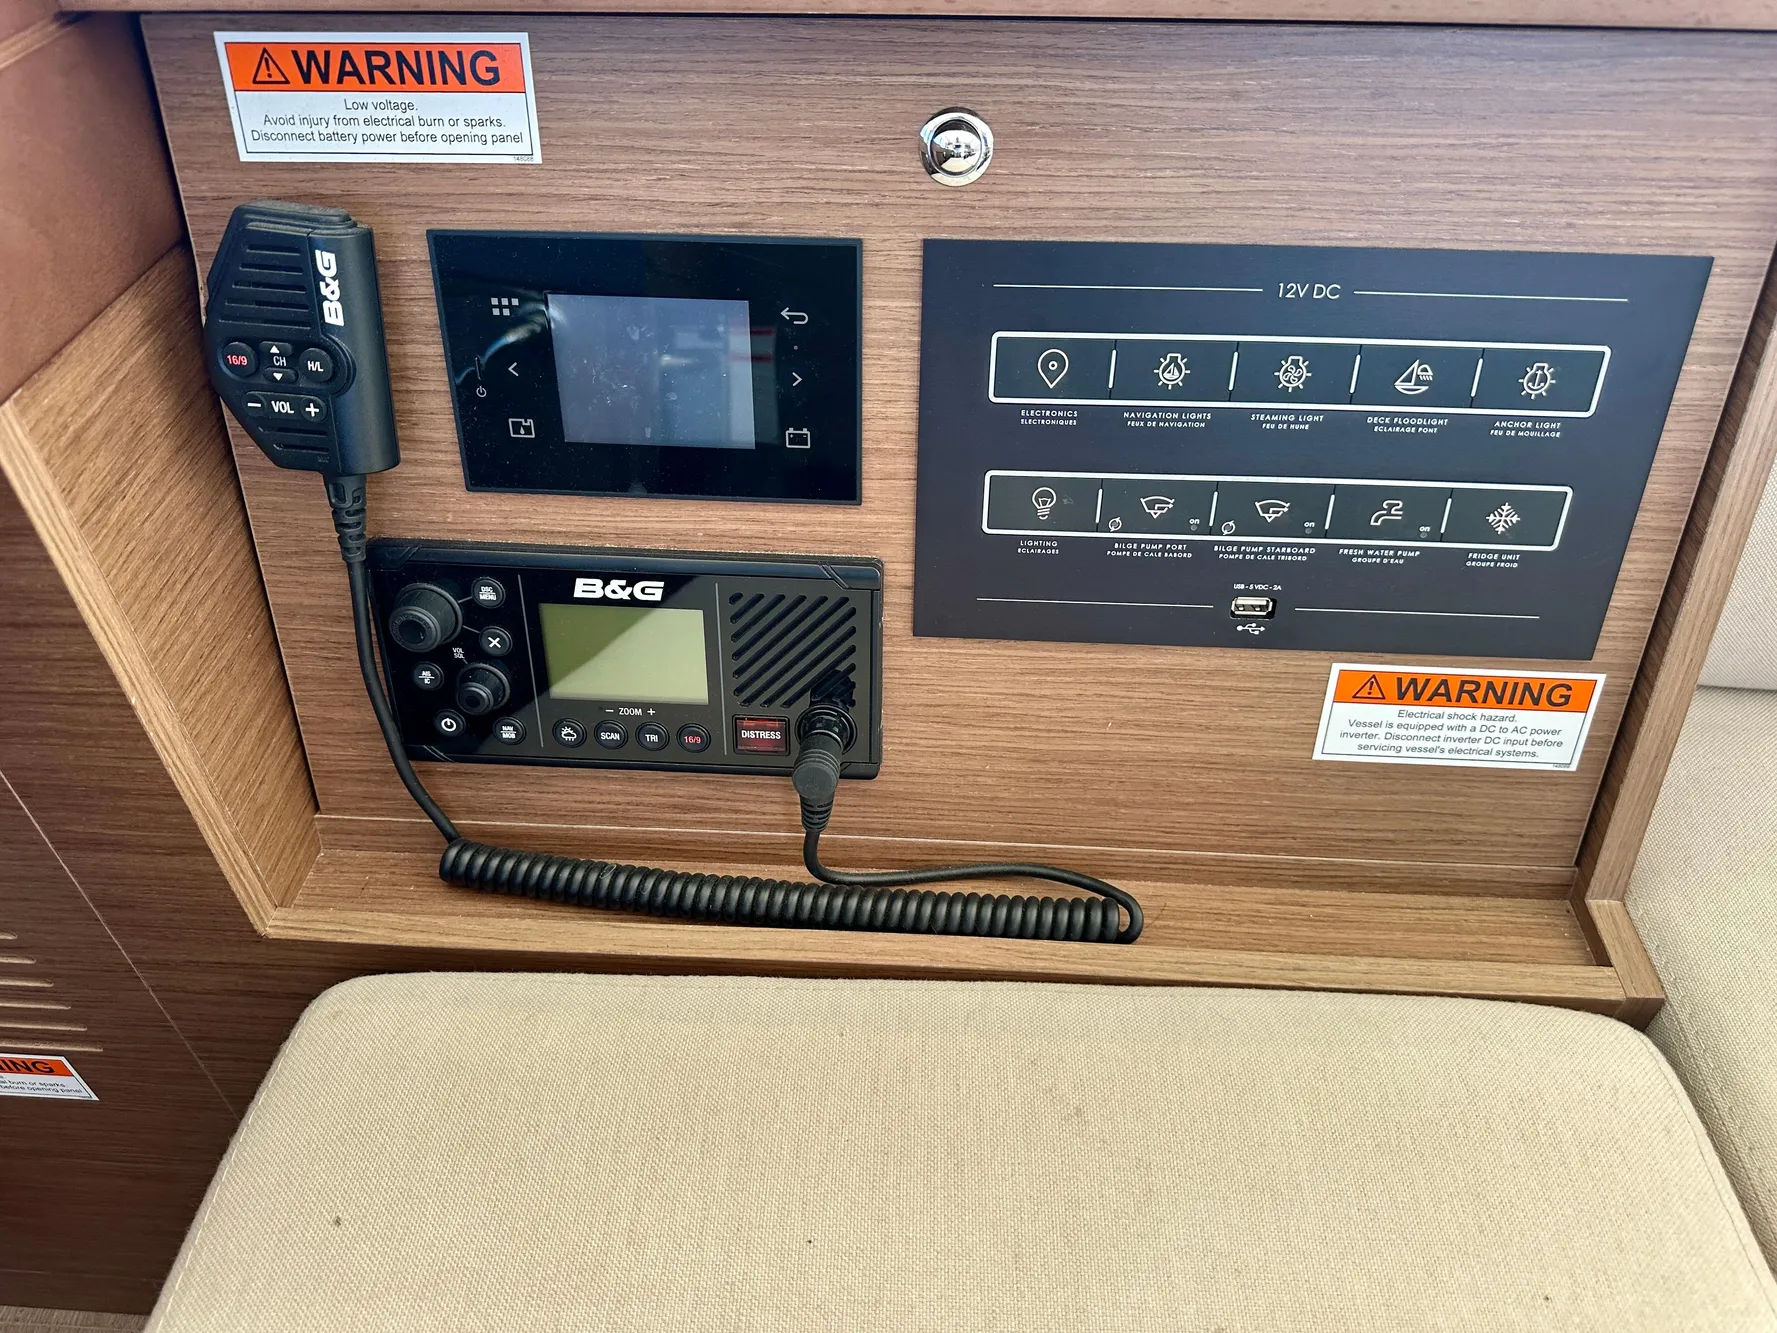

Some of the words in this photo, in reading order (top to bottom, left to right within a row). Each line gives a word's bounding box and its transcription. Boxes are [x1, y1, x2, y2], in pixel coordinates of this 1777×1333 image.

[291, 49, 500, 86] WARNING
[344, 99, 368, 110] Low
[372, 99, 418, 114] voltage.
[264, 114, 296, 126] Avoid
[298, 114, 330, 129] injury
[333, 114, 360, 126] from
[363, 115, 415, 127] electrical
[418, 115, 444, 127] burn
[448, 118, 460, 127] or
[464, 116, 506, 130] sparks.
[250, 130, 316, 141] Disconnect
[318, 130, 358, 144] battery
[361, 132, 397, 144] power
[400, 130, 438, 142] before
[440, 132, 488, 146] opening
[491, 132, 524, 146] panel
[315, 249, 345, 327] B&G
[1277, 283, 1309, 299] 12V
[1312, 284, 1341, 300] DC
[226, 354, 248, 366] 16/9
[273, 356, 287, 366] CH
[308, 360, 324, 372] H/L
[271, 400, 294, 414] VOL
[1020, 409, 1078, 418] ELECTRONICS
[1123, 411, 1179, 419] NAVIGATION
[1182, 412, 1212, 420] LIGHTS
[1250, 413, 1295, 422] STEAMING
[1298, 414, 1324, 422] LIGHT
[1020, 418, 1077, 426] ELECTRONIQUES
[1366, 416, 1390, 424] DECK
[1393, 417, 1449, 426] FLOODLIGHT
[1418, 426, 1438, 434] PONT
[1518, 430, 1561, 438] MOUILLAGE
[1020, 540, 1058, 548] LIGHTING
[1114, 542, 1138, 550] BILGE
[1266, 546, 1316, 554] STARBOARD
[1338, 548, 1364, 556] FRESH
[1468, 552, 1498, 560] FRIDGE
[1466, 560, 1495, 568] GROUPE
[574, 578, 664, 601] B&G
[1396, 676, 1572, 706] WARNING
[618, 708, 642, 716] ZOOM
[1398, 709, 1445, 720] Electrical
[1447, 712, 1476, 721] shock
[1480, 713, 1518, 723] hazard.
[1348, 719, 1383, 728] Vessel
[1385, 720, 1394, 729] is
[1396, 722, 1444, 732] equipped
[1446, 723, 1467, 732] with
[1479, 724, 1496, 734] DC
[1499, 726, 1508, 734] to
[1510, 726, 1528, 735] AC
[1530, 728, 1562, 736] power
[600, 732, 620, 741] SCAN
[645, 734, 658, 743] TRI
[684, 735, 701, 744] 16/9
[741, 730, 781, 740] DISTRESS
[1340, 730, 1380, 740] inverter.
[1384, 731, 1441, 742] Disconnect
[1443, 734, 1482, 744] inverter
[1484, 736, 1501, 745] DC
[1502, 737, 1528, 747] input
[1530, 738, 1564, 748] before
[1357, 743, 1402, 754] servicing
[1405, 745, 1445, 754] vessel's
[1448, 746, 1492, 756] electrical
[1494, 748, 1539, 758] systems.
[0, 1059, 54, 1074] ING
